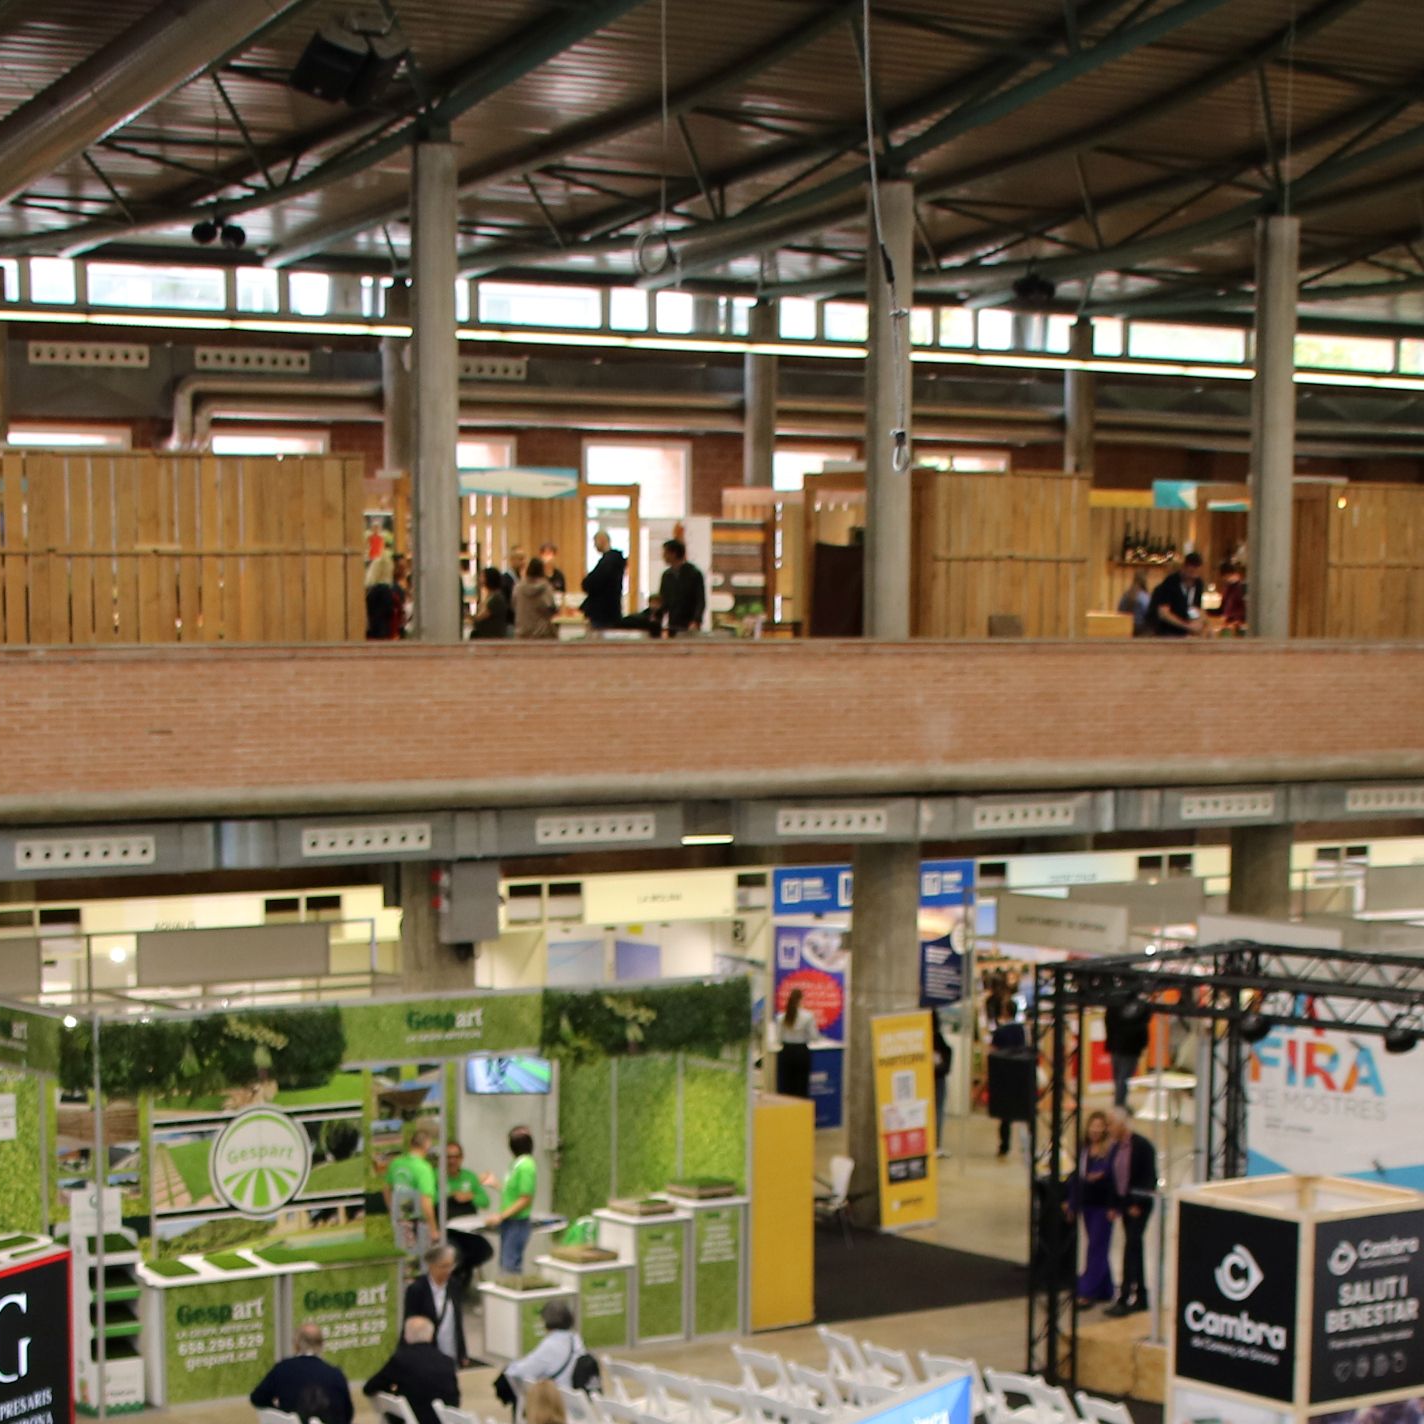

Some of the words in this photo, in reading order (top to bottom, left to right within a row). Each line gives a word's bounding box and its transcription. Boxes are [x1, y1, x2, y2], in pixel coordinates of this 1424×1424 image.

[1248, 1037, 1385, 1097] FIRA
[225, 1143, 295, 1164] Gespart
[1357, 1236, 1419, 1260] Cambra
[304, 1283, 388, 1310] Gespart
[1338, 1279, 1398, 1307] SALUT
[176, 1297, 264, 1327] Gespart
[1184, 1300, 1287, 1351] Cambra
[1325, 1297, 1420, 1334] BENESTAR
